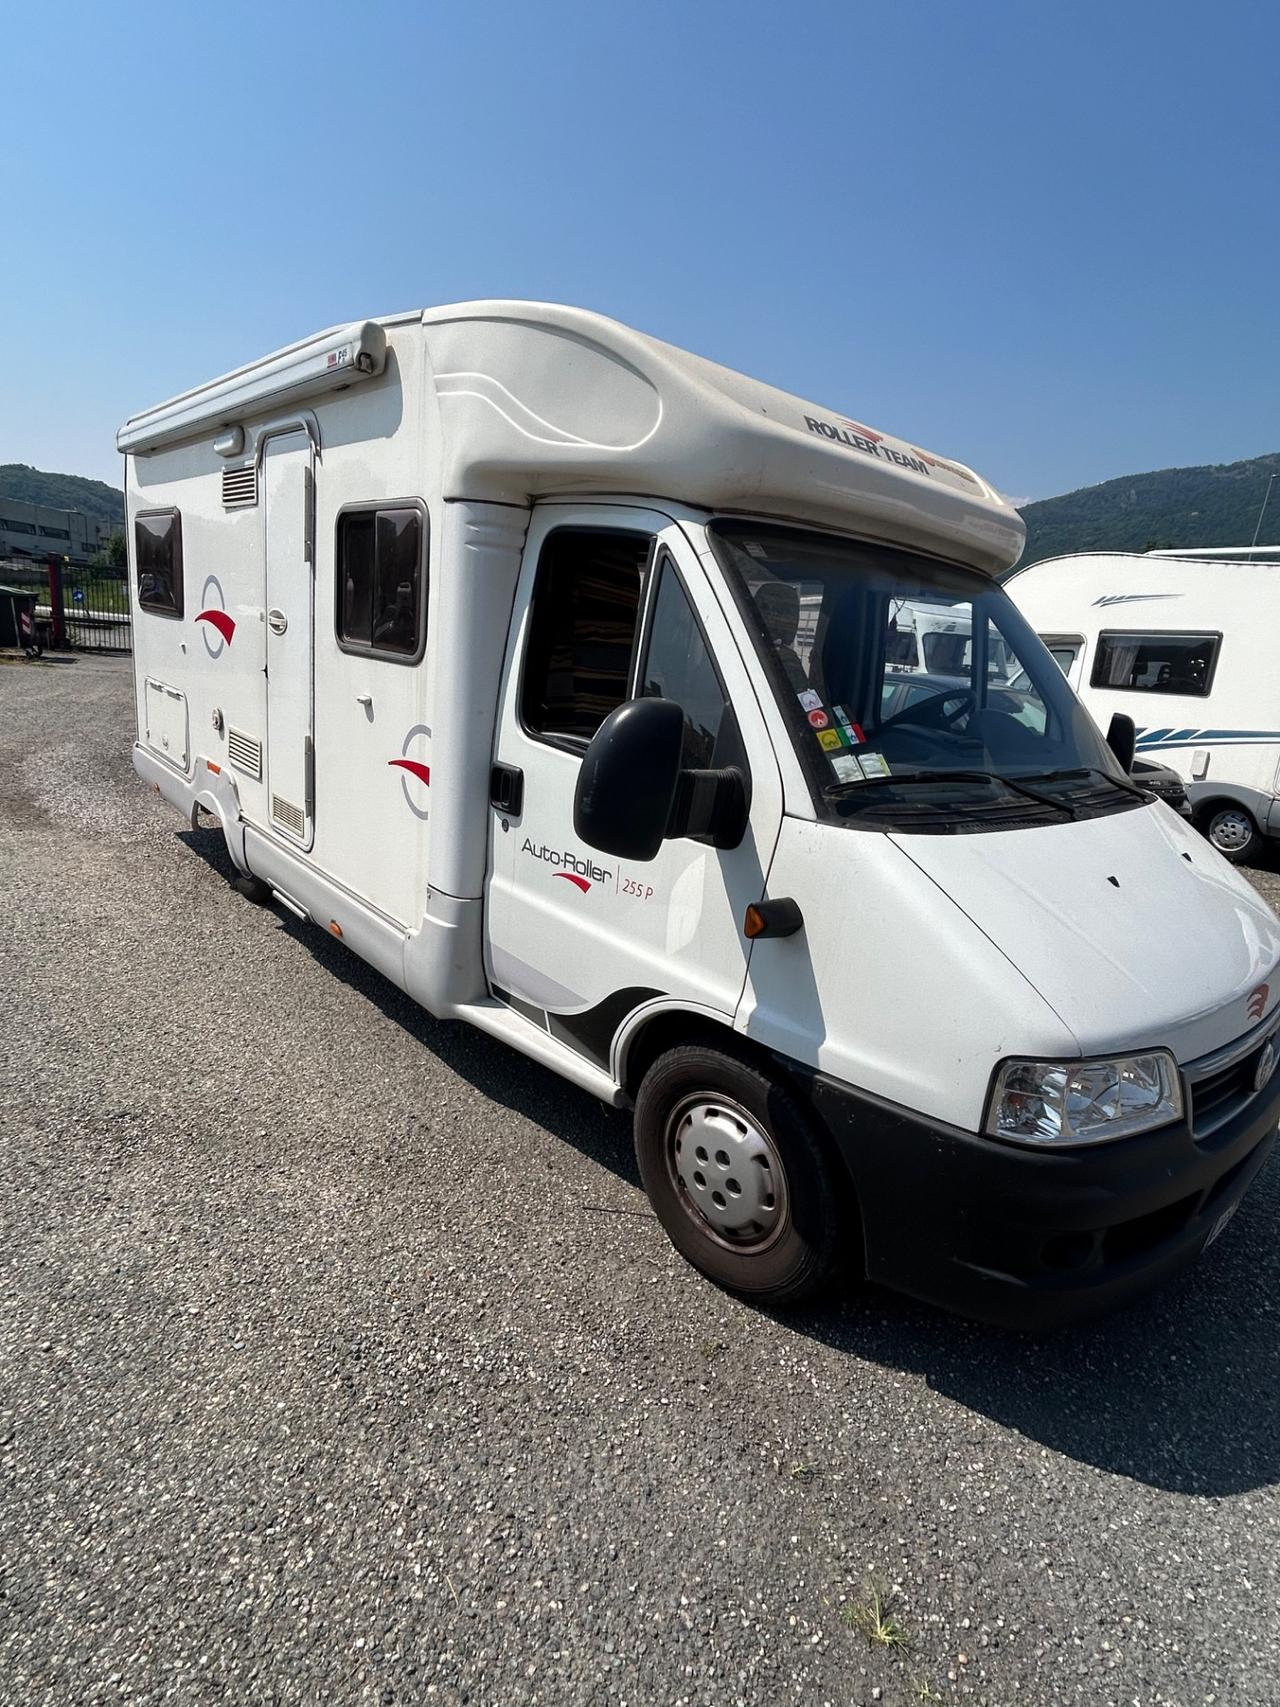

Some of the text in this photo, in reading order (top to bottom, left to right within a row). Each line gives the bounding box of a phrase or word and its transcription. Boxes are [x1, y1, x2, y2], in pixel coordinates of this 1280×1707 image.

[803, 415, 880, 457] ROLLER
[880, 446, 930, 475] TEAM
[521, 837, 613, 884] Auto-Roller
